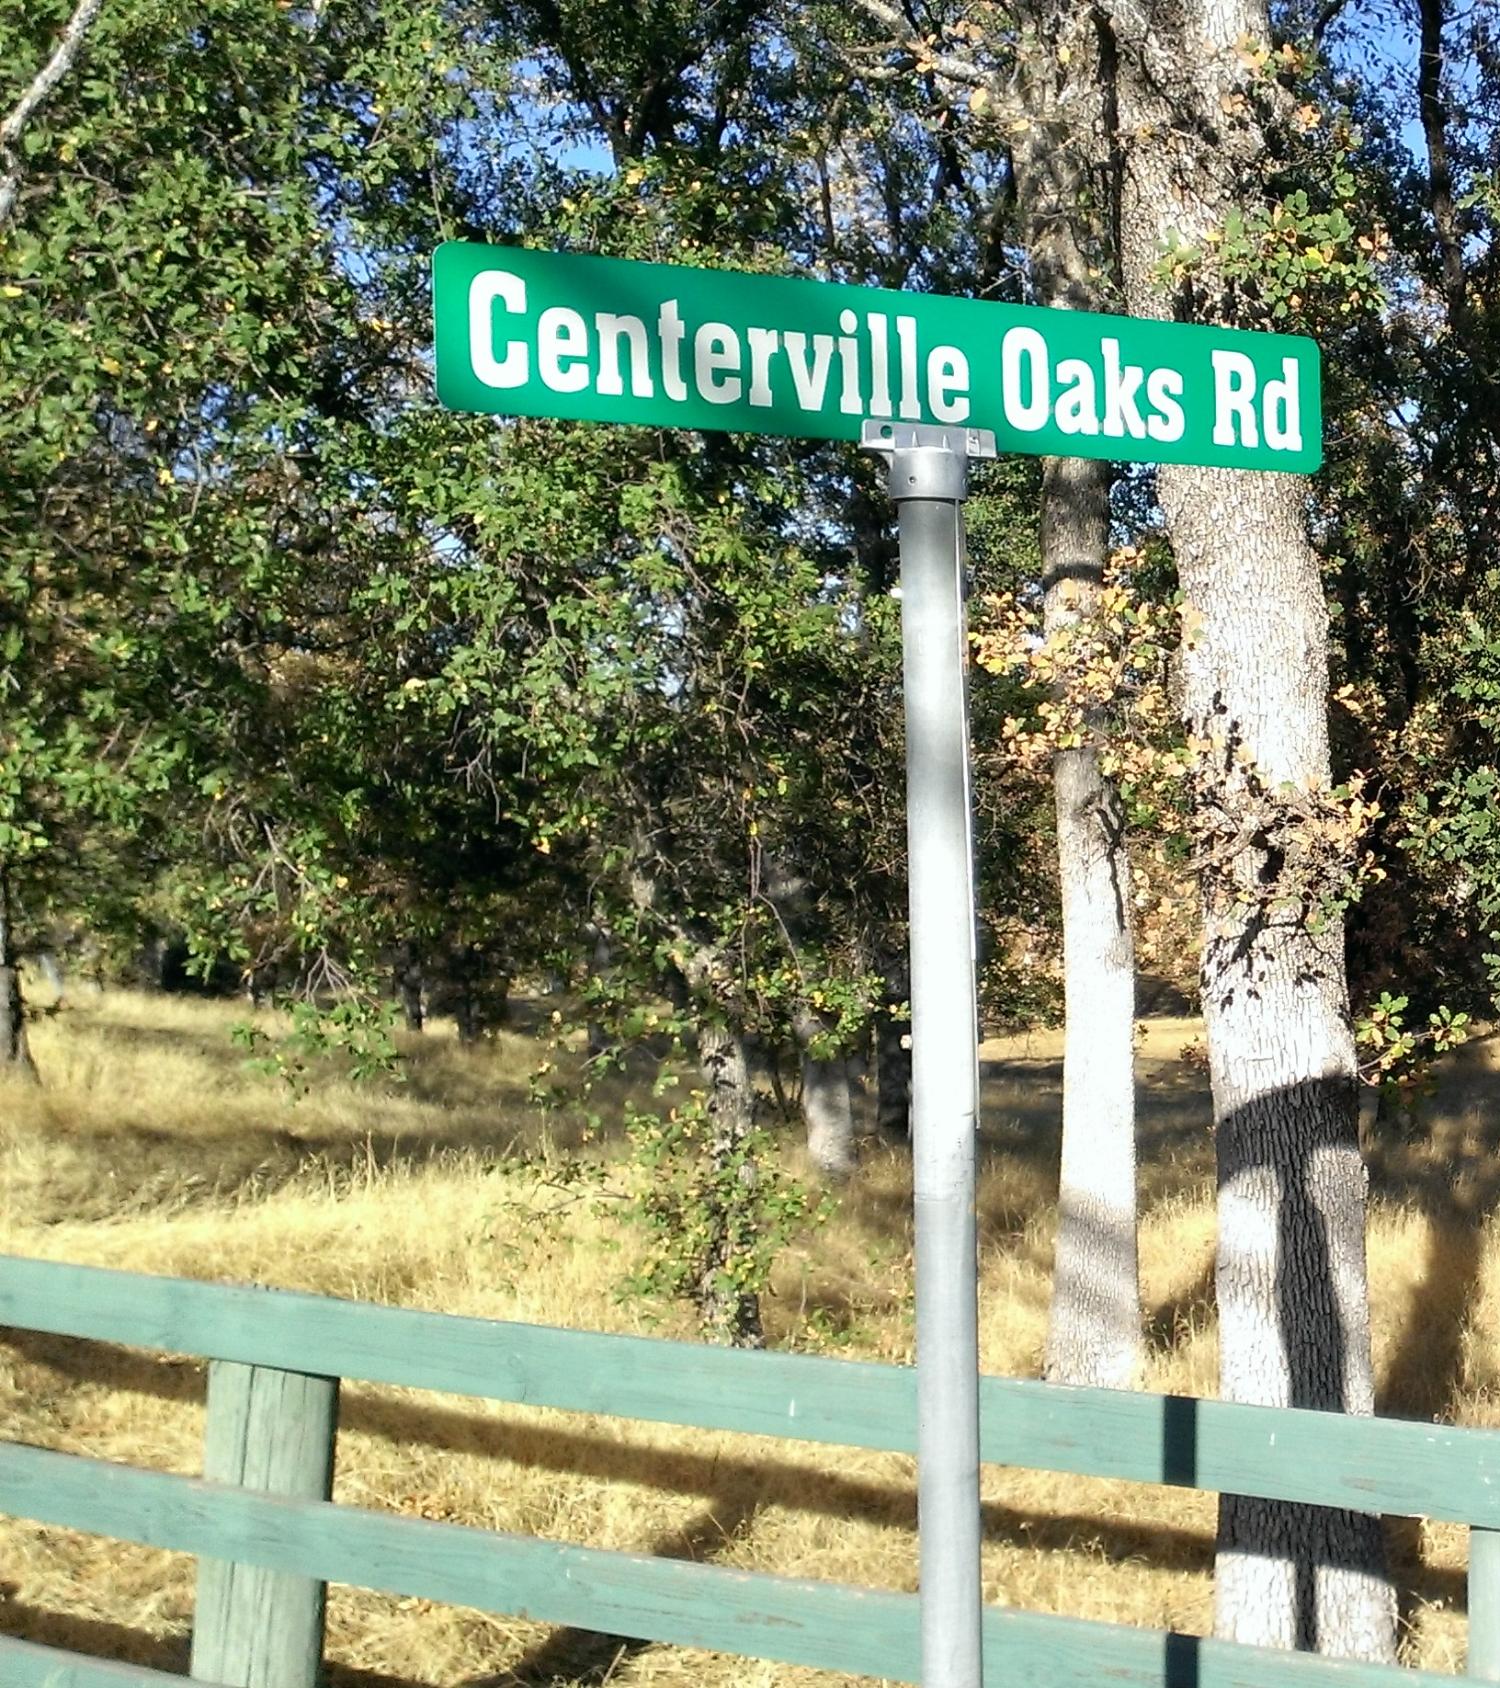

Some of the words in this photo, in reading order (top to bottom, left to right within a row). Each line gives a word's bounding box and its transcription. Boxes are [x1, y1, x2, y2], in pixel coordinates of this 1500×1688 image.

[468, 269, 971, 425] Centerville
[1002, 326, 1186, 443] Oaks
[1211, 349, 1304, 452] Rd
